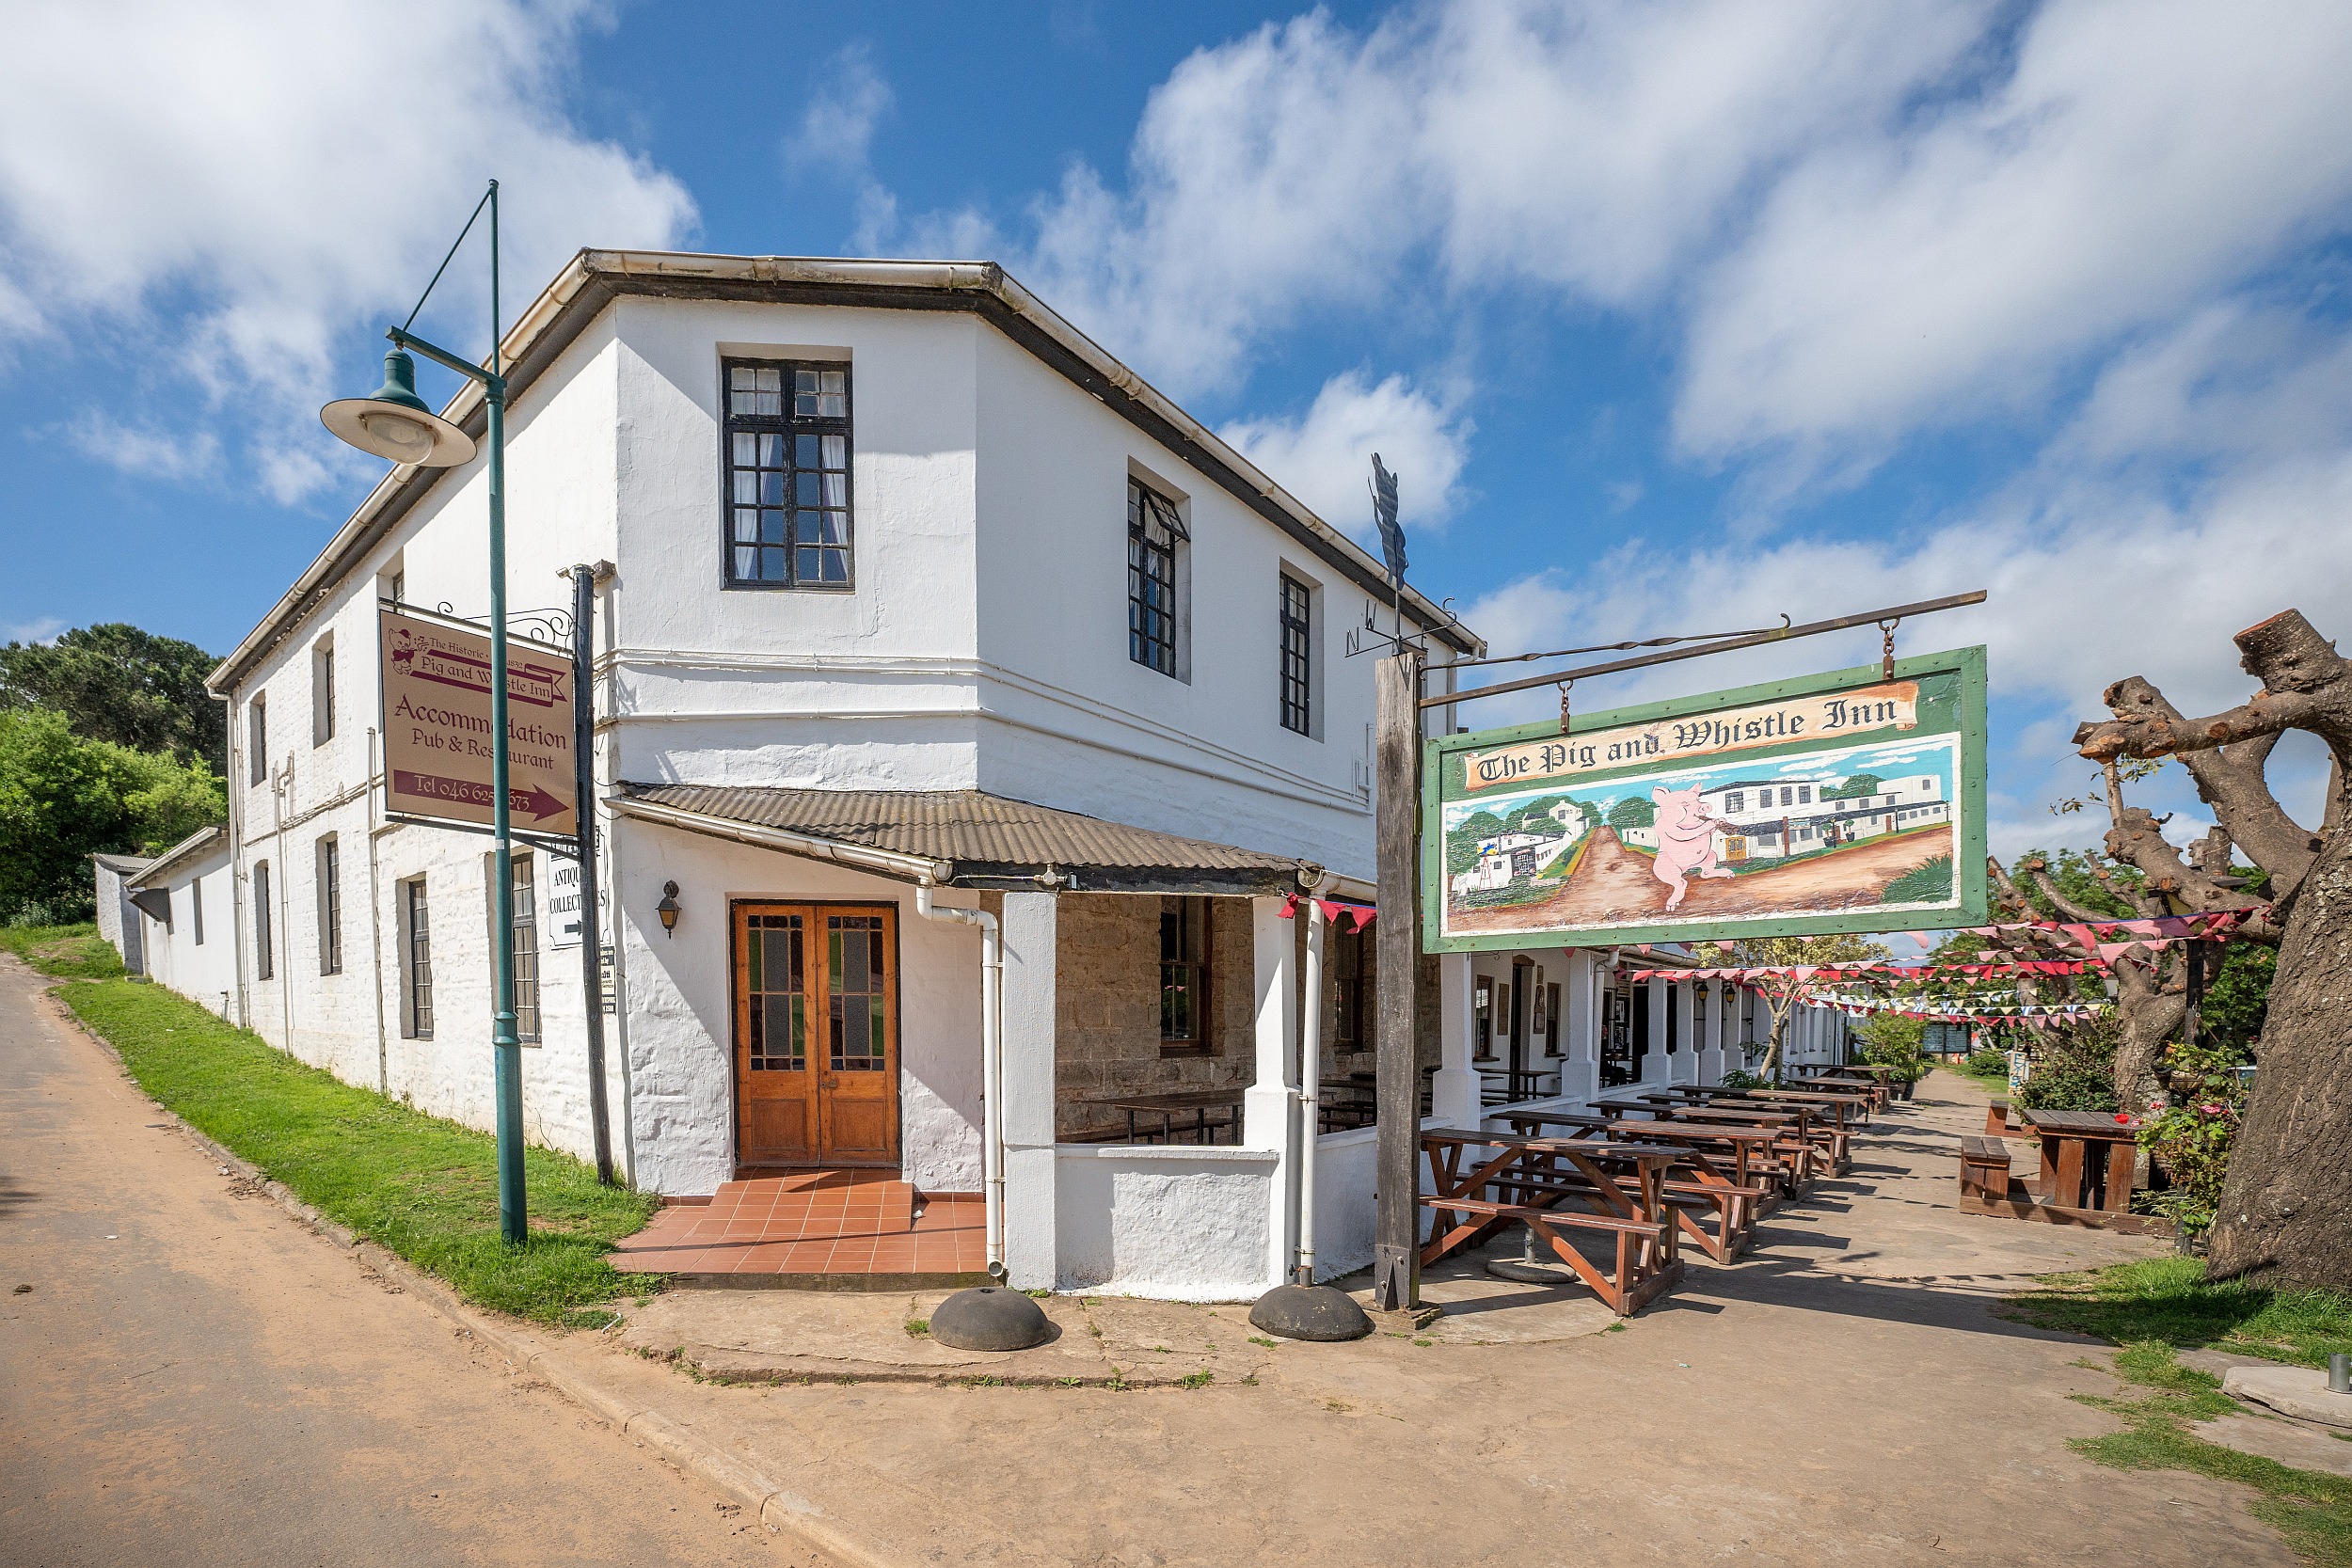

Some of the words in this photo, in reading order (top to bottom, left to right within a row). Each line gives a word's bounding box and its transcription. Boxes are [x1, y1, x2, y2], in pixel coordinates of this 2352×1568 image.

[430, 637, 446, 649] The
[449, 642, 484, 658] Historic
[421, 656, 444, 675] Pig
[448, 666, 473, 680] and
[476, 670, 526, 692] Wstle
[530, 682, 550, 698] Inn
[394, 693, 567, 750] Accommdation
[1476, 753, 1531, 782] The
[1539, 740, 1596, 774] Pig
[1607, 733, 1660, 761] and
[1673, 709, 1805, 750] Whistle
[1822, 699, 1897, 730] Inn
[411, 728, 444, 750] Pub
[449, 736, 463, 753] &
[467, 738, 555, 770] Resurant
[414, 775, 436, 794] Tel
[440, 780, 469, 800] 046
[472, 784, 495, 807] 625
[554, 867, 580, 888] ANTIQU
